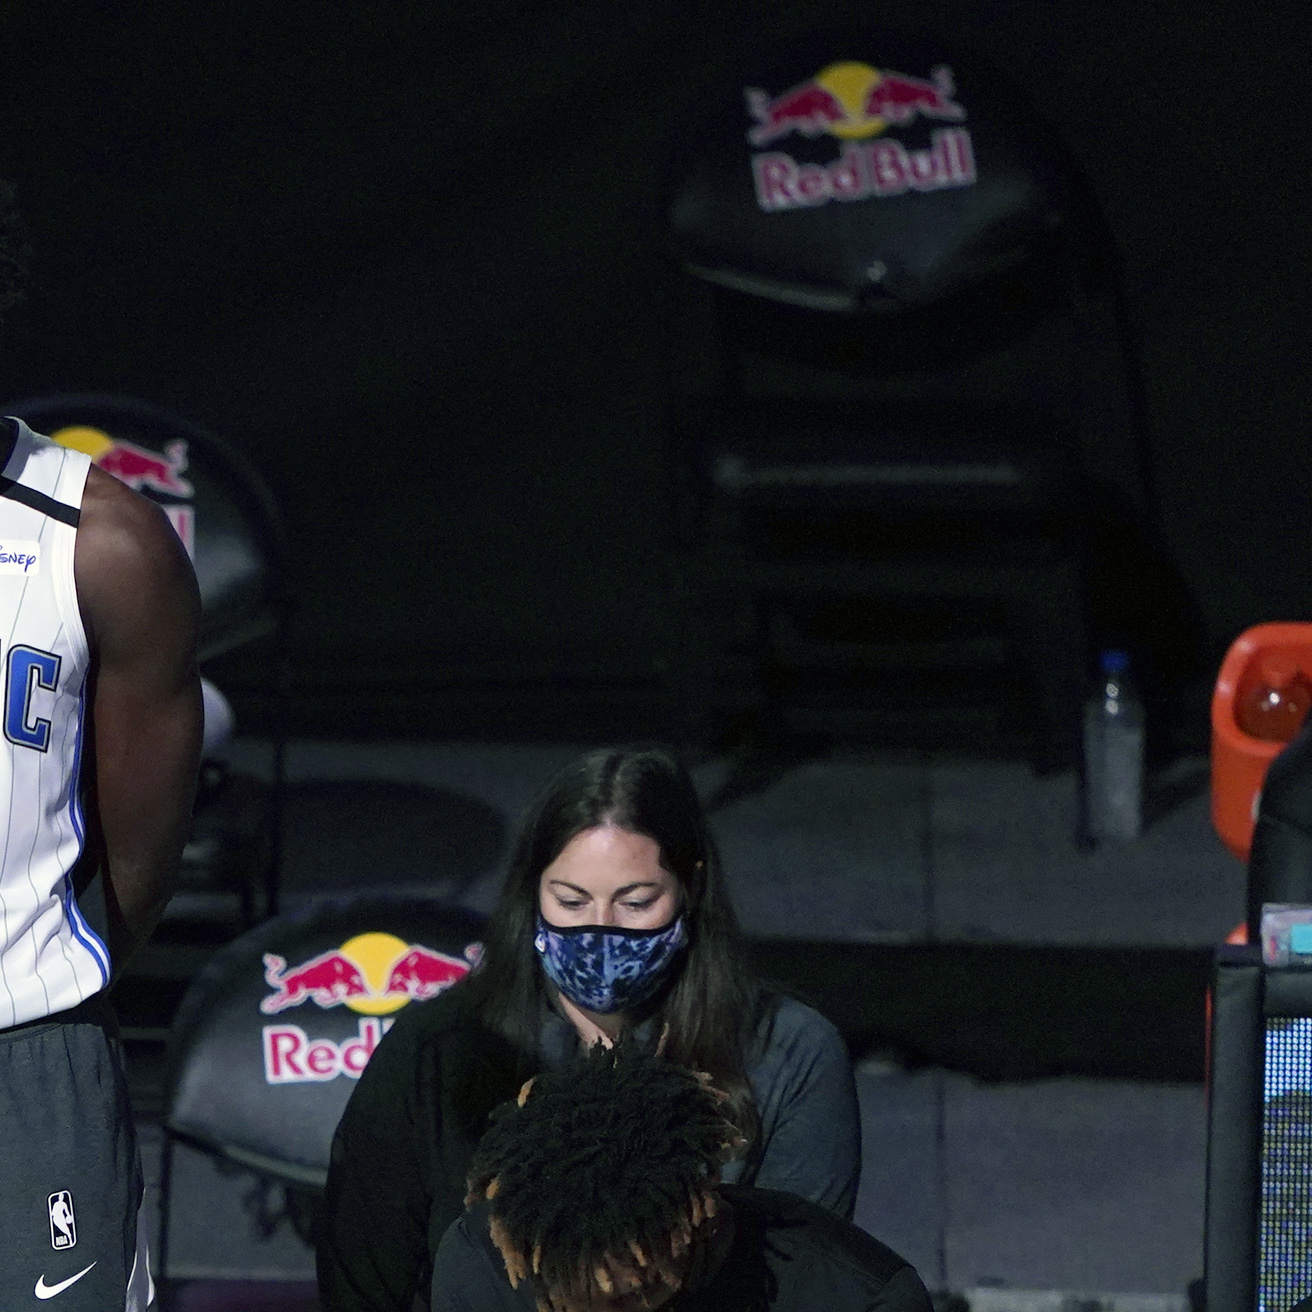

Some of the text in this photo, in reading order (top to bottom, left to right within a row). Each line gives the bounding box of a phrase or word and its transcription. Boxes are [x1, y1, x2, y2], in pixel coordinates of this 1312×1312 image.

[752, 126, 976, 214] Red Bull
[262, 1017, 381, 1084] Red
